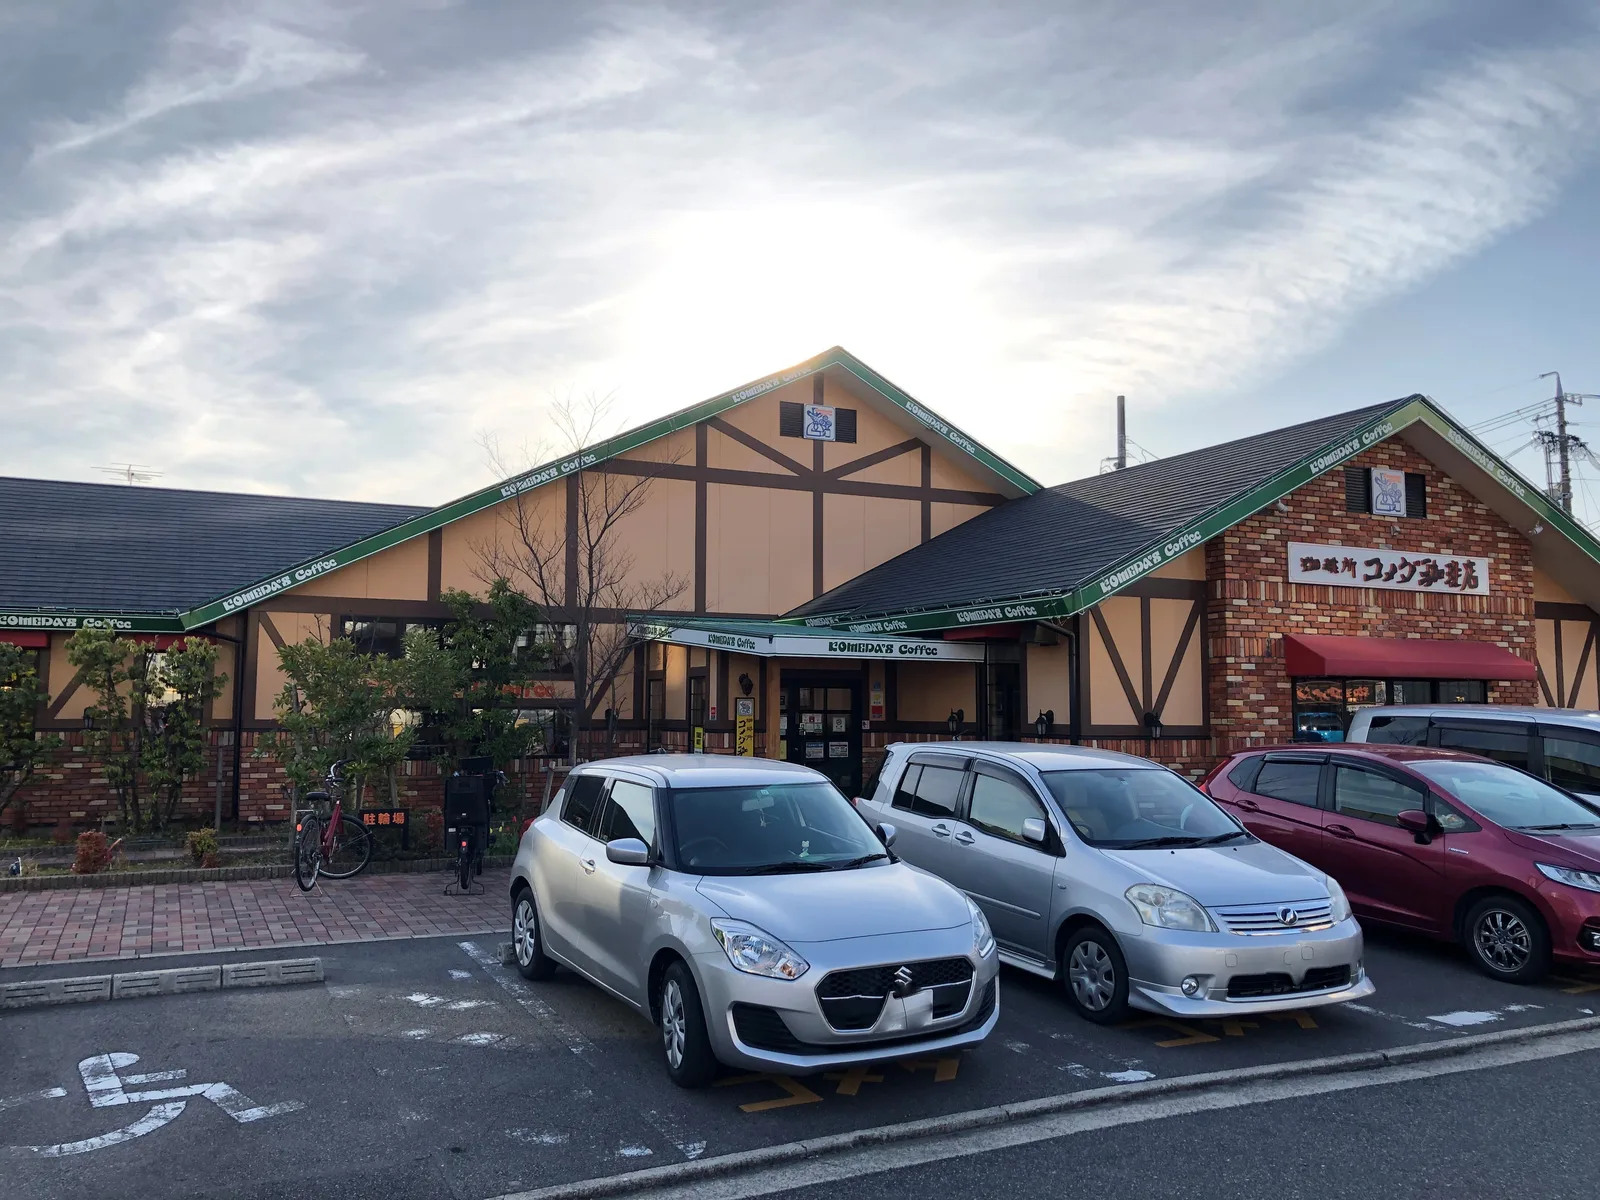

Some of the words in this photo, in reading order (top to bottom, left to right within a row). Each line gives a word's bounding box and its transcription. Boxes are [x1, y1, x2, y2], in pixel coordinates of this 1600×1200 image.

[905, 401, 948, 434] KOMEDA'S
[949, 431, 976, 454] Coffee
[1309, 438, 1360, 474] KOMEDA'S
[1362, 422, 1393, 445] Coffee
[1496, 469, 1525, 497] Coffee
[1100, 551, 1161, 593] KOMEDA'S
[1164, 529, 1202, 558] Coffee
[222, 575, 291, 612] KOMEDA'S
[295, 557, 338, 582] Coffee
[957, 608, 1003, 624] KOMEDA'S
[1004, 604, 1038, 619] Coffee
[736, 638, 756, 650] Coffee
[828, 641, 894, 654] KOMEDA'S
[898, 644, 938, 656] Coffee
[363, 812, 405, 826] 駐輪場
